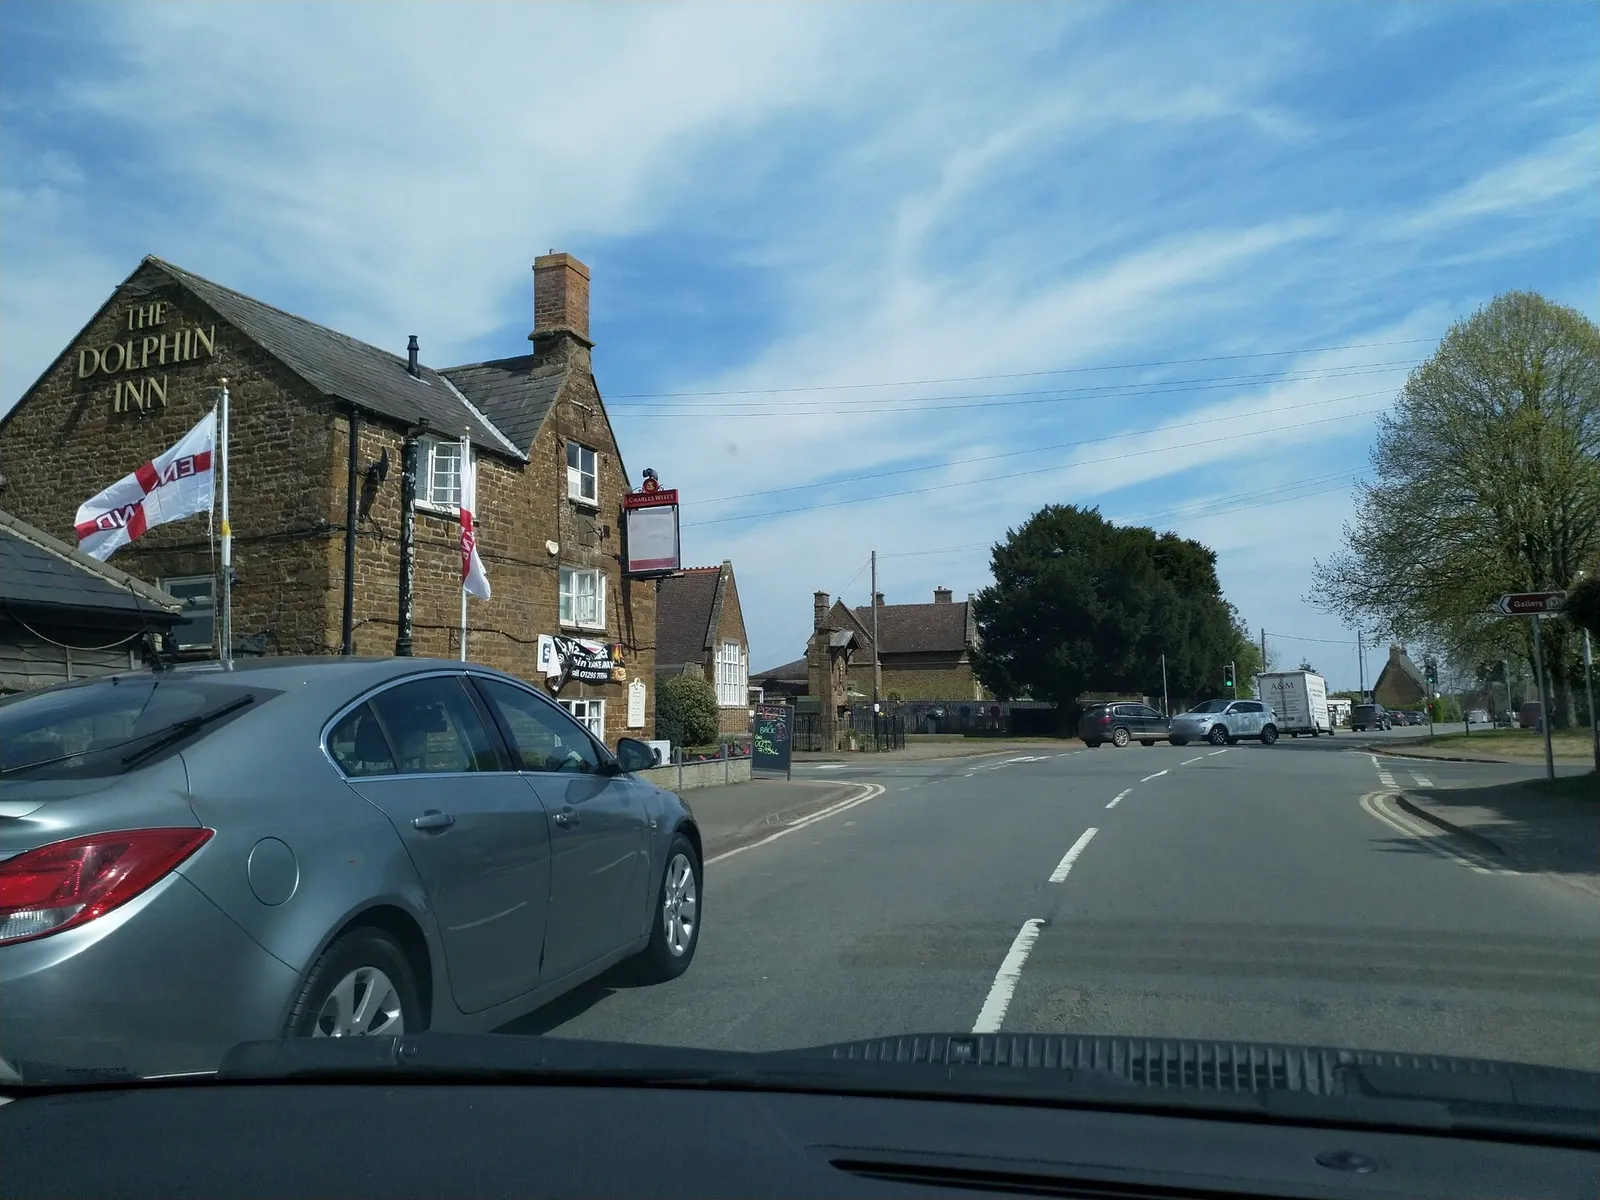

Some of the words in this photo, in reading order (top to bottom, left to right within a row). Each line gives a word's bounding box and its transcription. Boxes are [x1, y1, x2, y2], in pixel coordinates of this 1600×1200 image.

[126, 302, 166, 330] THE
[79, 325, 215, 379] DOLPHIN
[114, 375, 168, 414] INN
[628, 495, 655, 504] CHARLES
[655, 493, 675, 502] WELLS
[1513, 600, 1544, 608] Gallery
[1270, 681, 1295, 690] A&M
